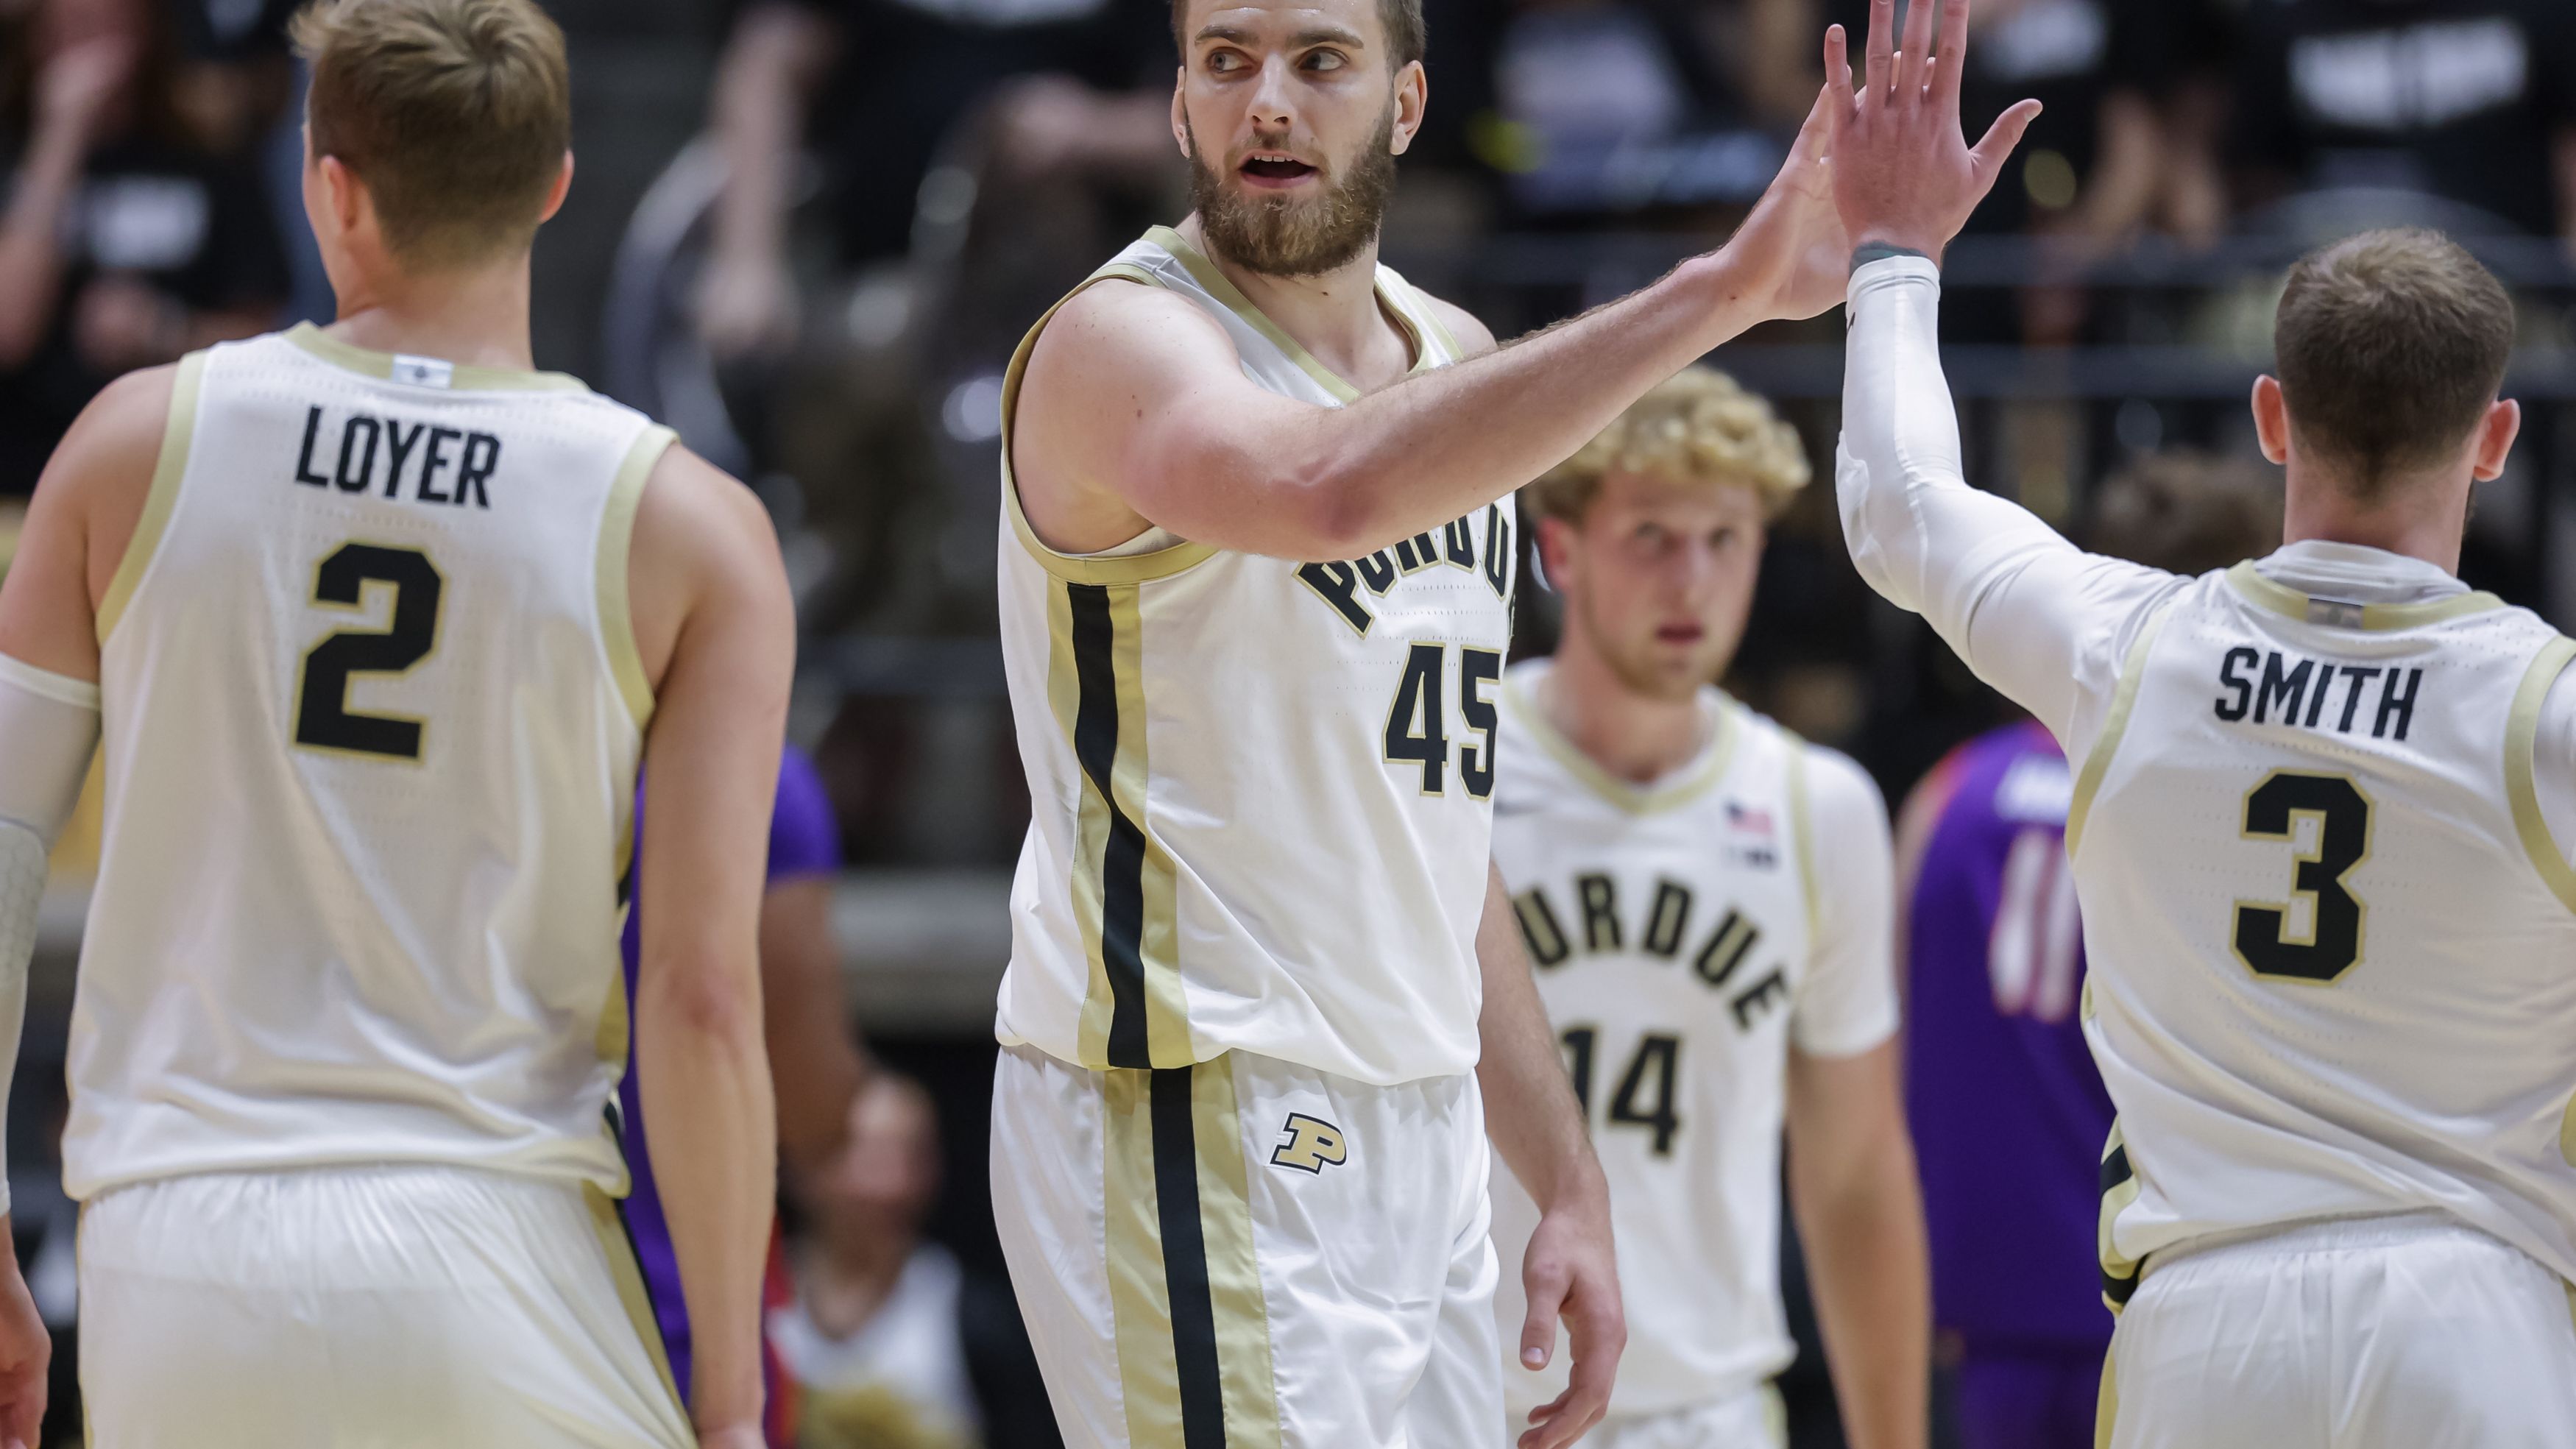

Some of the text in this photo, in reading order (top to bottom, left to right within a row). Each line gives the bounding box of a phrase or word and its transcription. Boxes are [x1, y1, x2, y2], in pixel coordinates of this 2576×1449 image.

[296, 405, 501, 509] LOYER
[290, 540, 447, 766] 2
[1381, 641, 1501, 801] 45
[2214, 646, 2423, 741] SMITH
[1512, 871, 1790, 1030] URDUE
[2229, 768, 2375, 986] 3
[1270, 1112, 1347, 1175] P
[1559, 1023, 1682, 1160] 14
